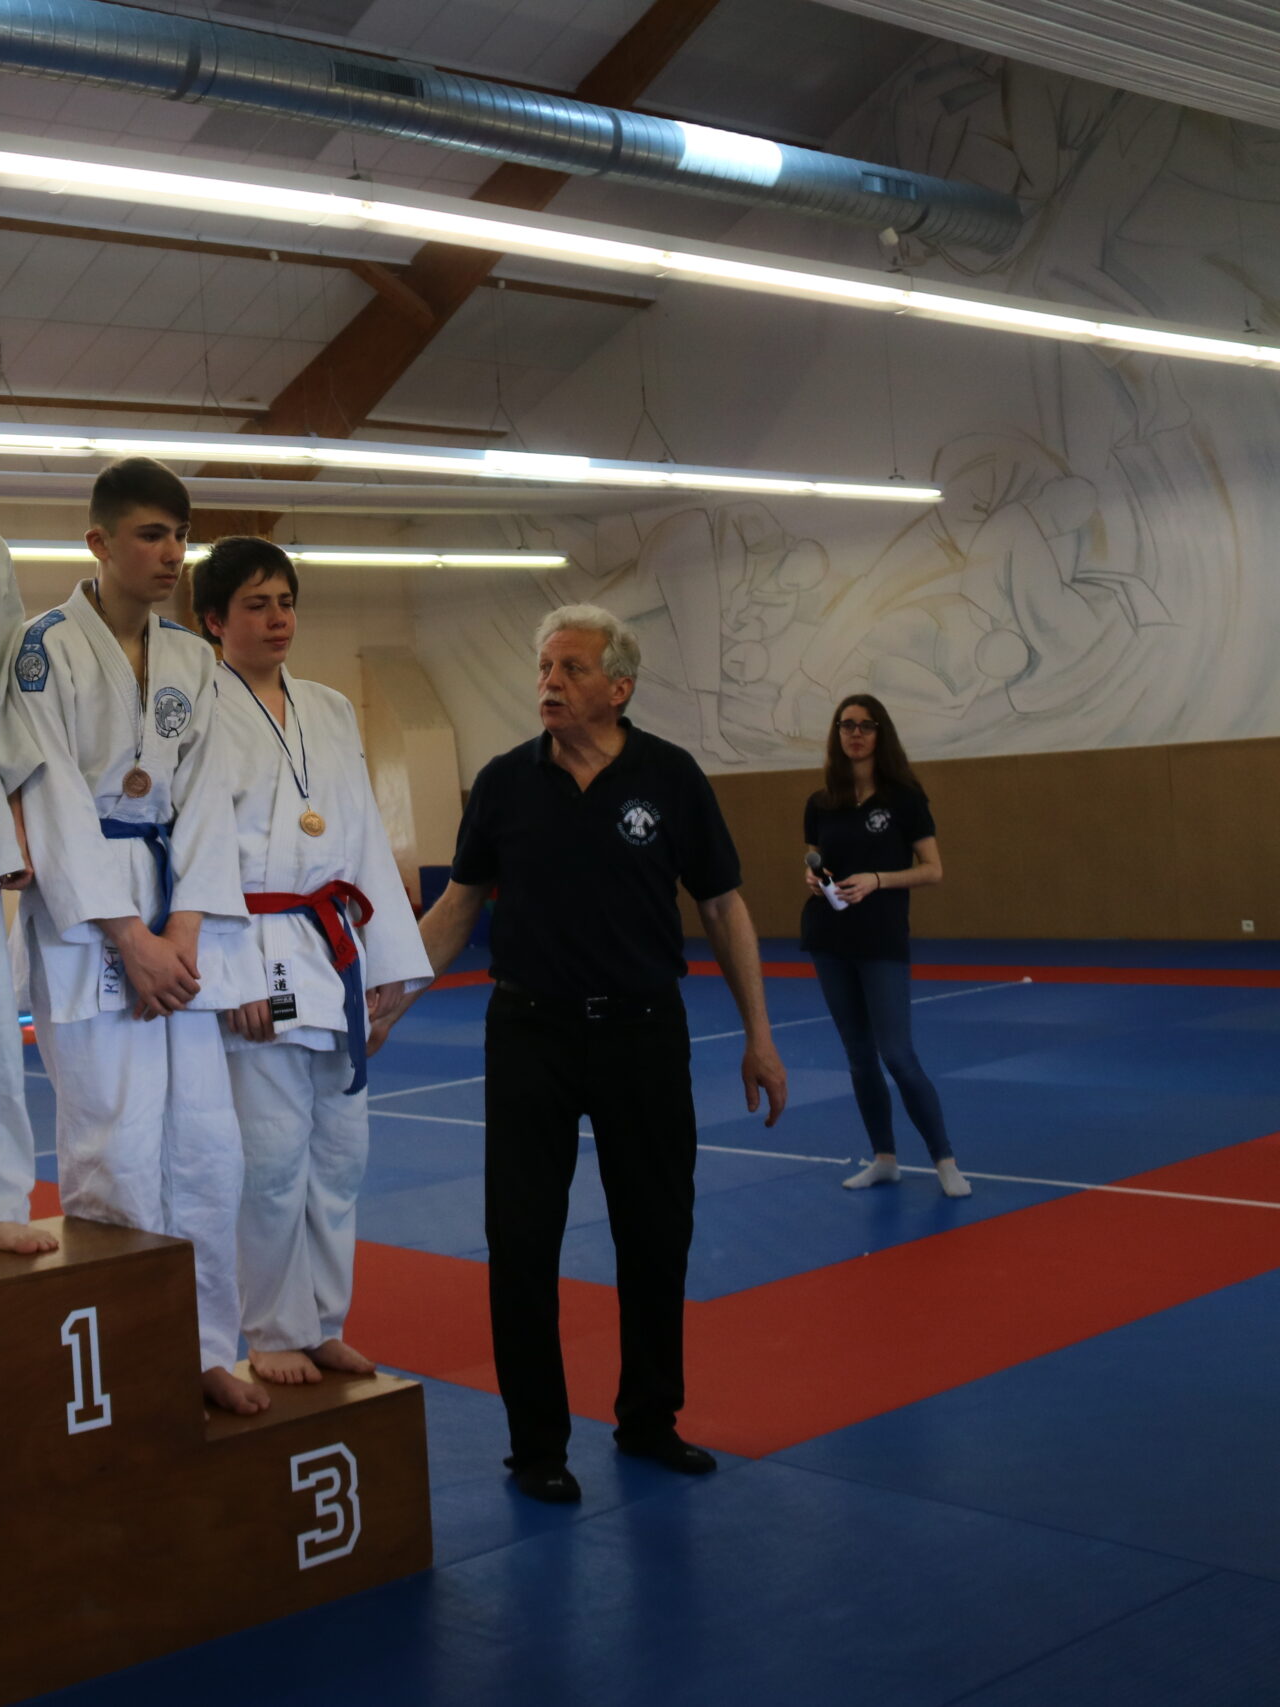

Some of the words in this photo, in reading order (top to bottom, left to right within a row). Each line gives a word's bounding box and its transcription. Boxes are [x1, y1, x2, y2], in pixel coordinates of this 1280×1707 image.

[273, 963, 288, 991] 柔道
[61, 1307, 112, 1435] 1
[290, 1442, 361, 1571] 3
